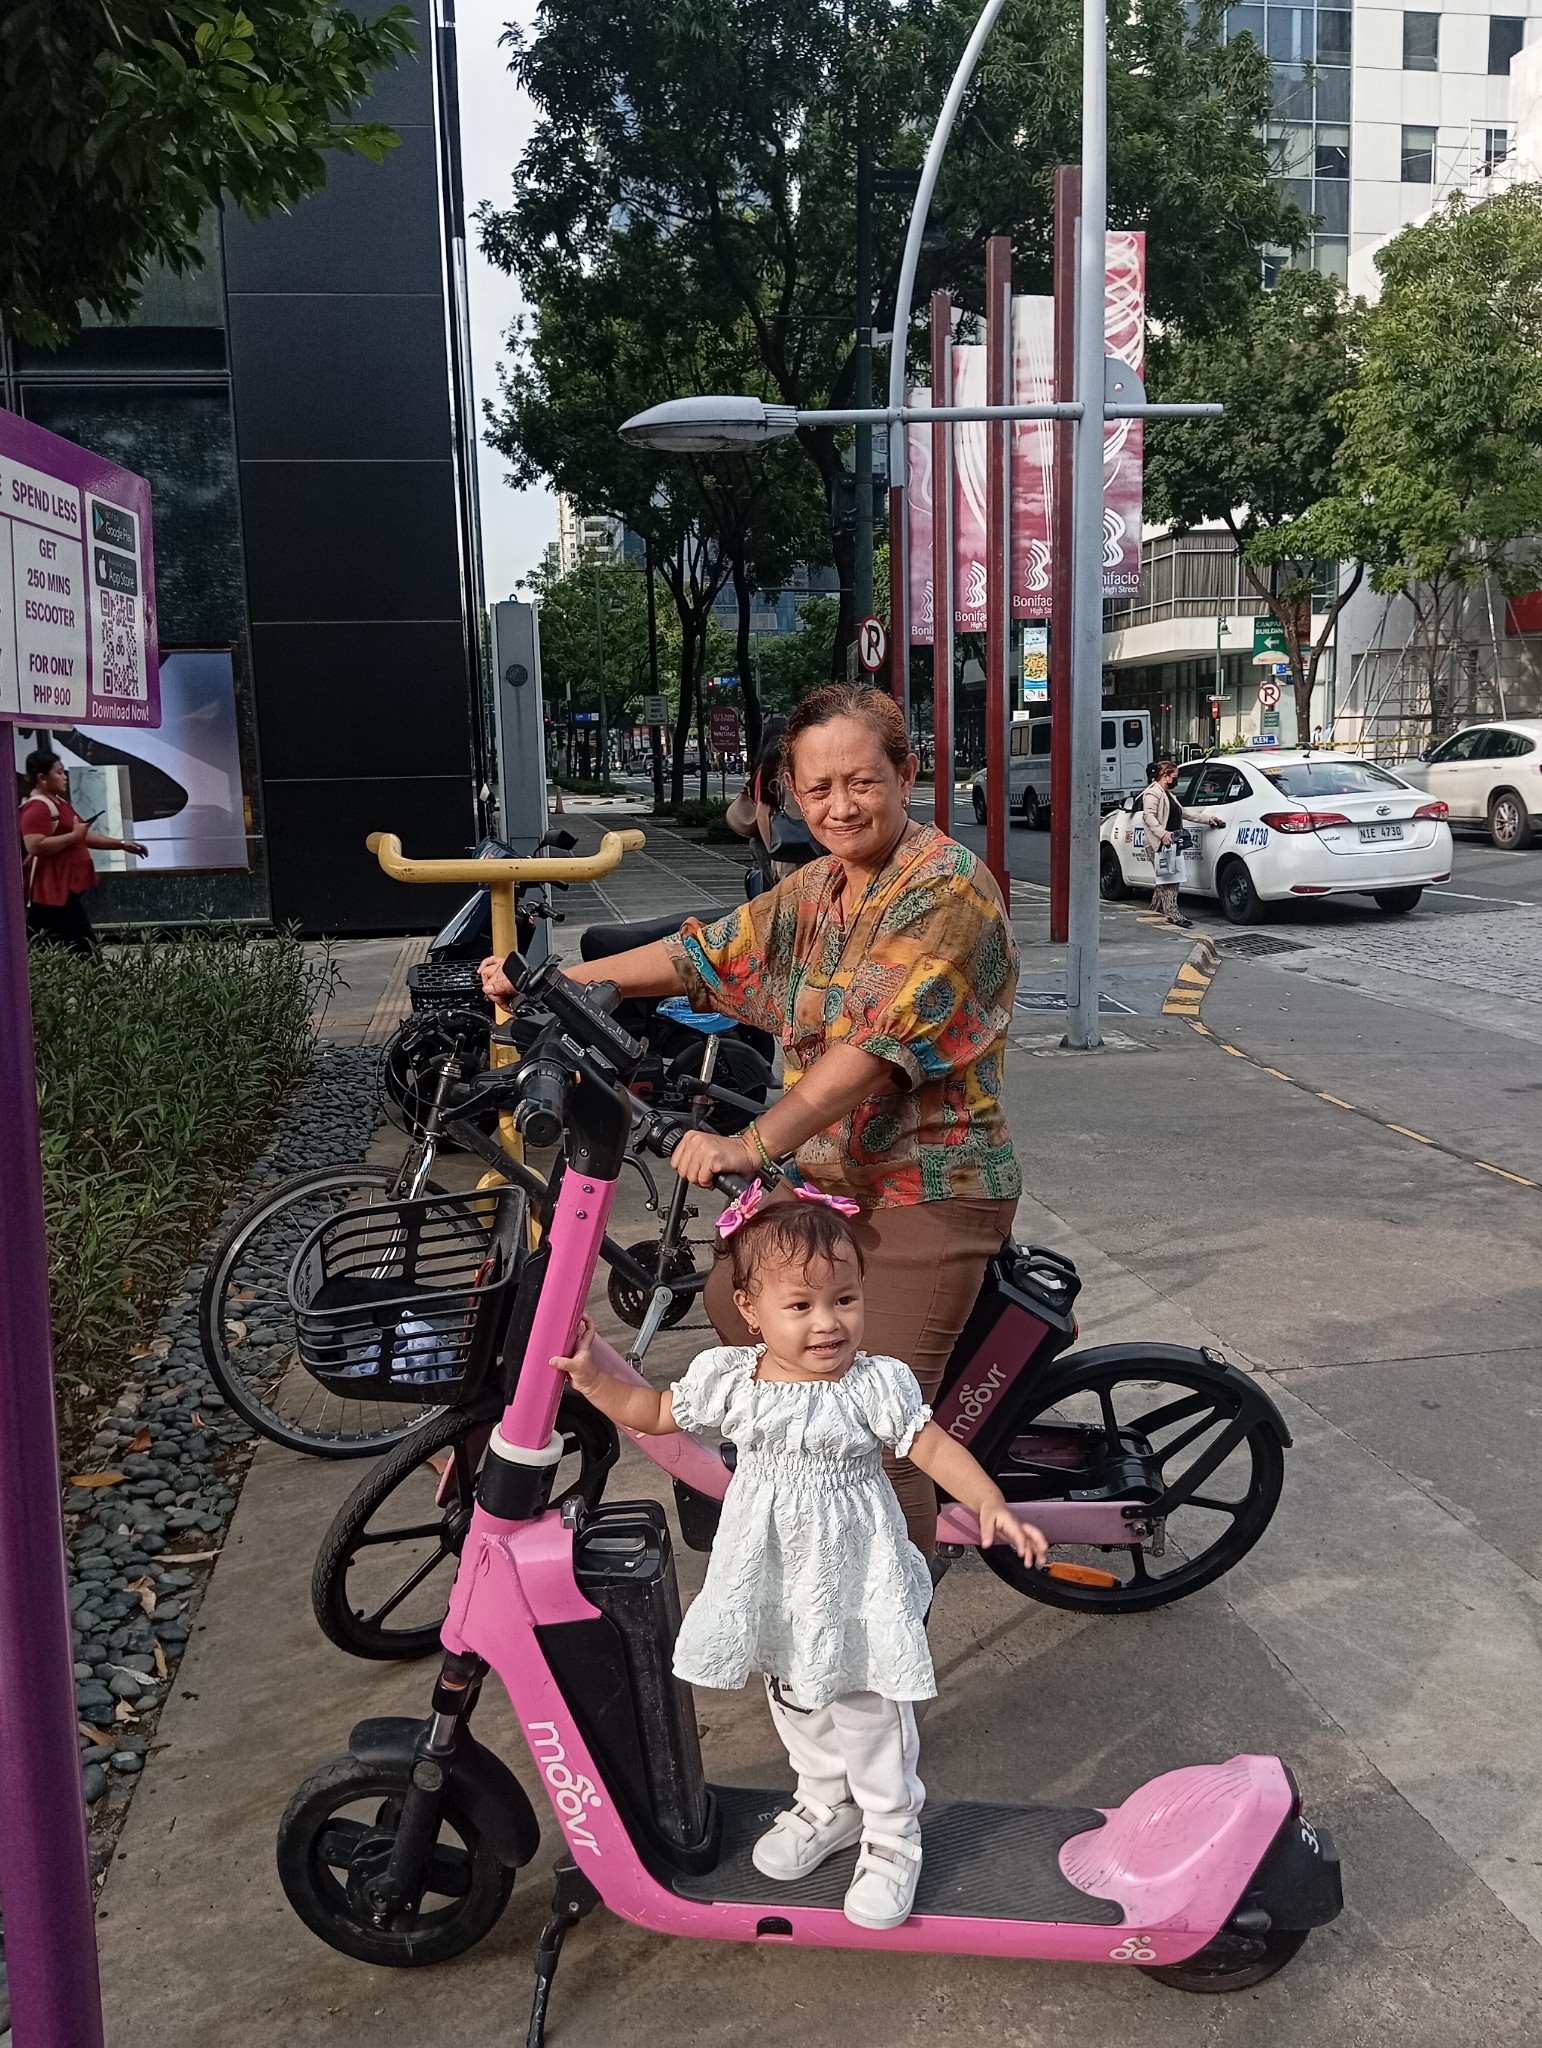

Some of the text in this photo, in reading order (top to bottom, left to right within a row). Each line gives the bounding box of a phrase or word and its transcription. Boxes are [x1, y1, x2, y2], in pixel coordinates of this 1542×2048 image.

[12, 479, 50, 513] SPEND
[52, 494, 77, 524] LESS
[105, 521, 133, 546] Google Play
[39, 538, 57, 560] GET
[27, 568, 71, 596] 250 MINS
[108, 567, 135, 589] App Store
[1118, 585, 1138, 593] Street
[1013, 594, 1052, 607] Bonifac
[25, 599, 75, 628] ESCOOTER
[955, 610, 987, 622] Bonifa
[1030, 608, 1043, 616] High
[970, 621, 982, 630] High
[29, 653, 74, 677] FOR ONLY
[33, 684, 71, 706] PHP 900
[92, 701, 149, 721] Download Now!
[1253, 736, 1269, 744] KEN
[1235, 827, 1269, 845] NIE 4730
[1360, 826, 1402, 838] NIE 4730
[946, 1363, 1008, 1440] moovr
[528, 1721, 602, 1857] moovr
